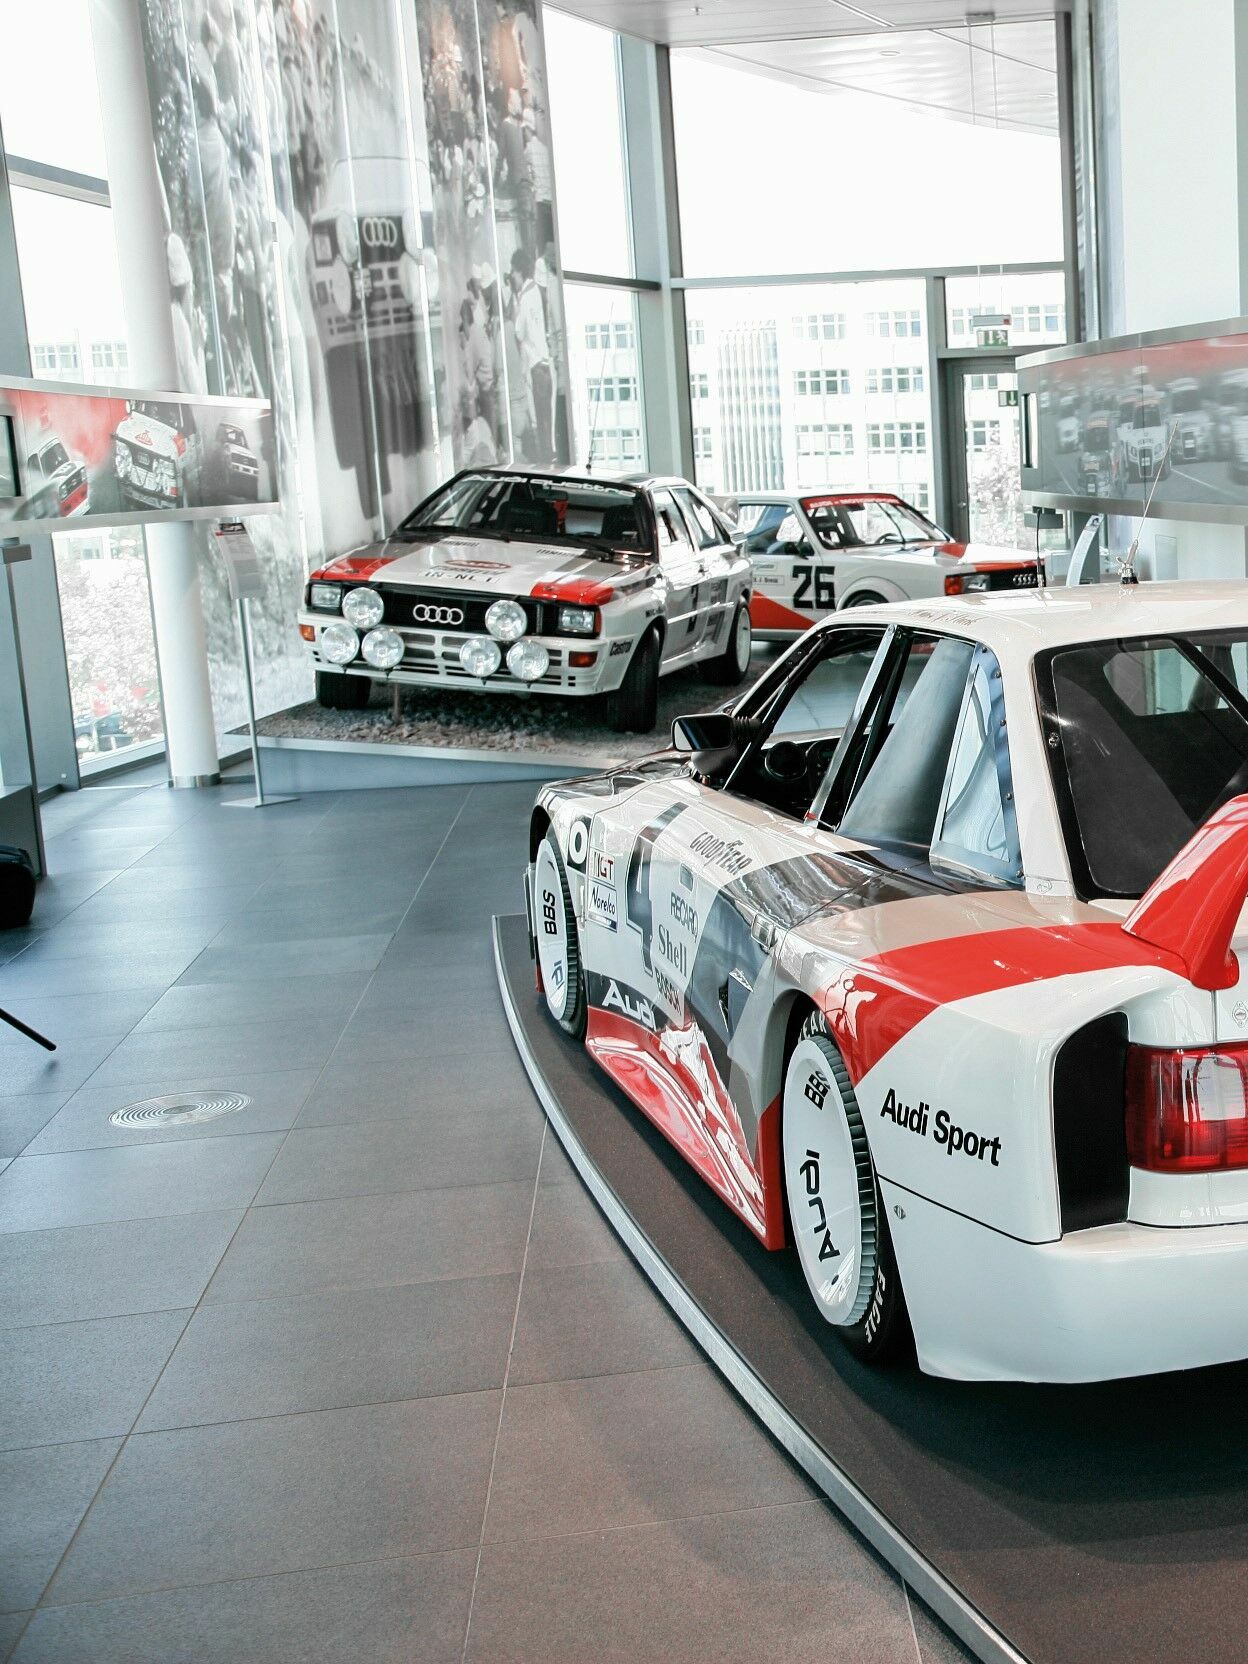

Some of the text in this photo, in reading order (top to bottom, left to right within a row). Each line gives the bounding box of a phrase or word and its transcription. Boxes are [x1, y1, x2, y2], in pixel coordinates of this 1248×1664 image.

[462, 474, 637, 498] Audi quattro
[792, 565, 836, 609] 26
[689, 831, 753, 876] GOODYEAR
[543, 889, 558, 935] BBS
[588, 884, 617, 917] Norelco
[658, 923, 688, 978] Shell
[601, 979, 658, 1032] Audi
[880, 1087, 1002, 1167] Audi Sport
[799, 1149, 841, 1263] Audi
[864, 1264, 887, 1344] EAGLE
